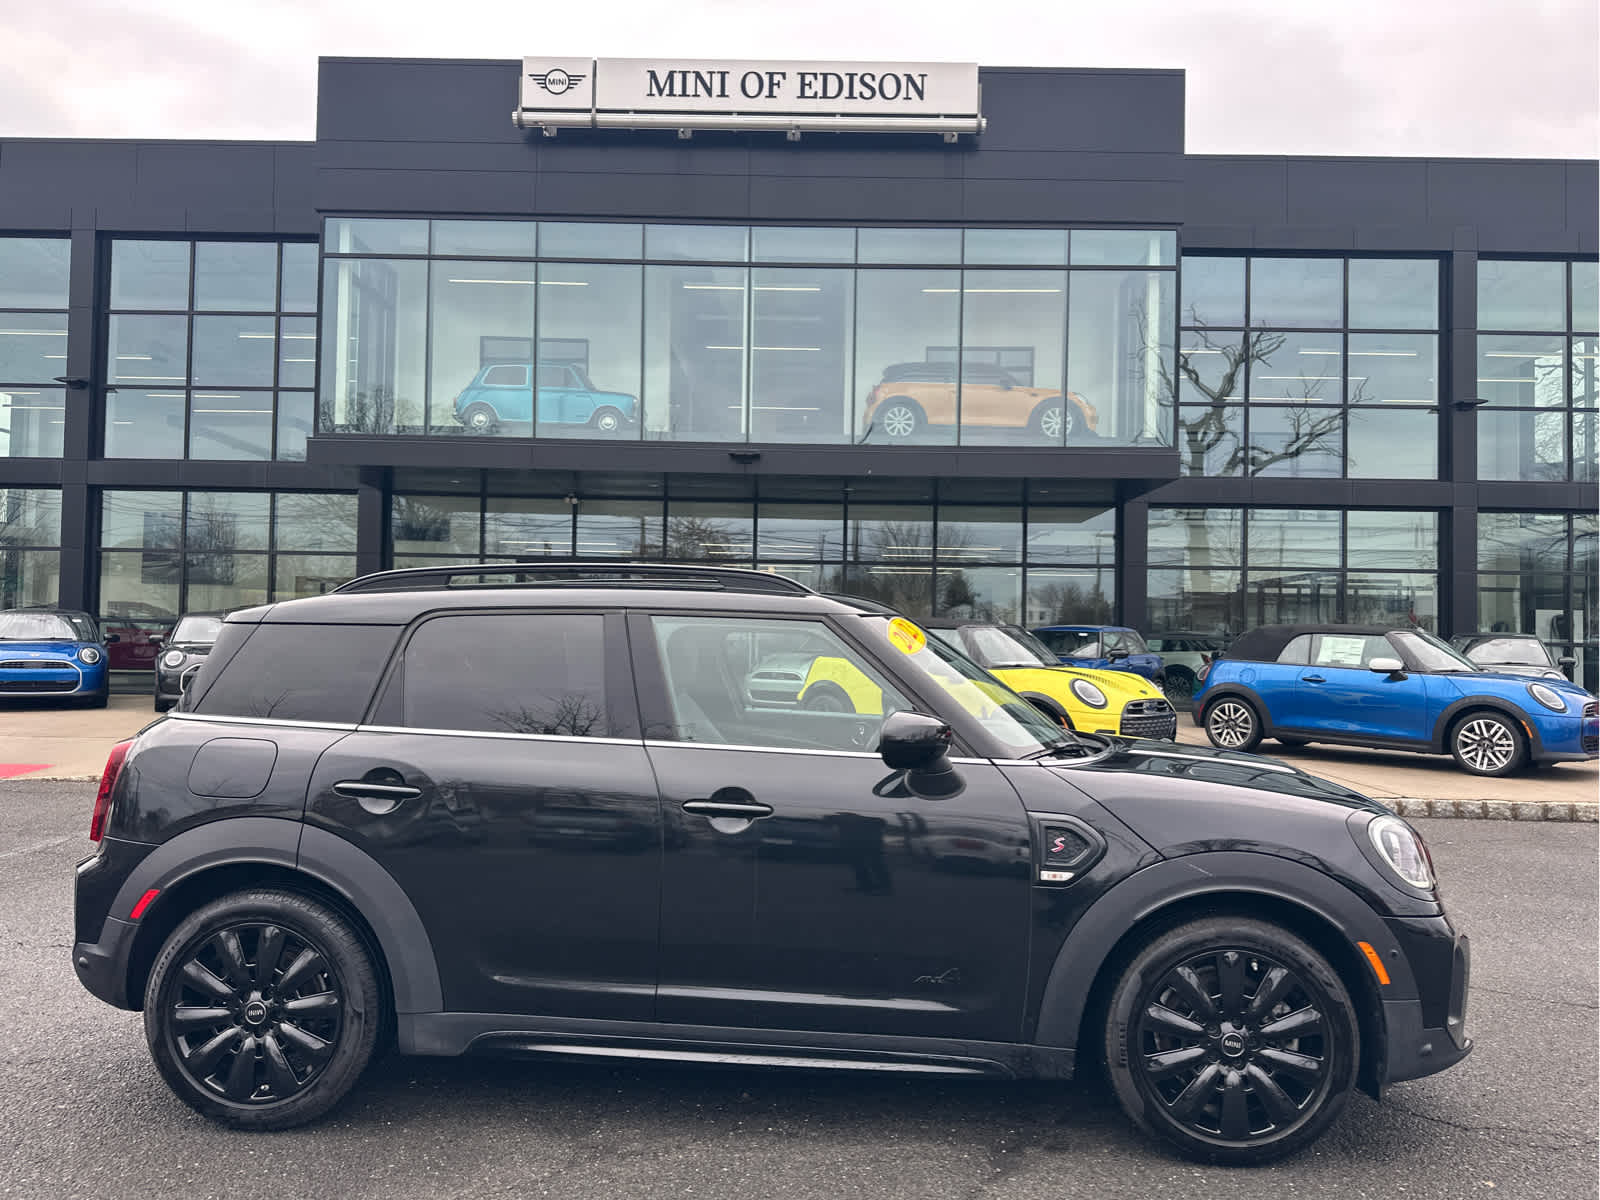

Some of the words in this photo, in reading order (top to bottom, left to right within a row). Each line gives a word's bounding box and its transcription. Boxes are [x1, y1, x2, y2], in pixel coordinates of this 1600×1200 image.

[547, 78, 567, 86] MINI
[646, 69, 730, 98] MINI
[740, 71, 787, 99] OF
[796, 72, 928, 101] EDISON
[1050, 836, 1066, 853] S
[248, 1009, 264, 1017] MINI
[1224, 1039, 1241, 1049] MINI
